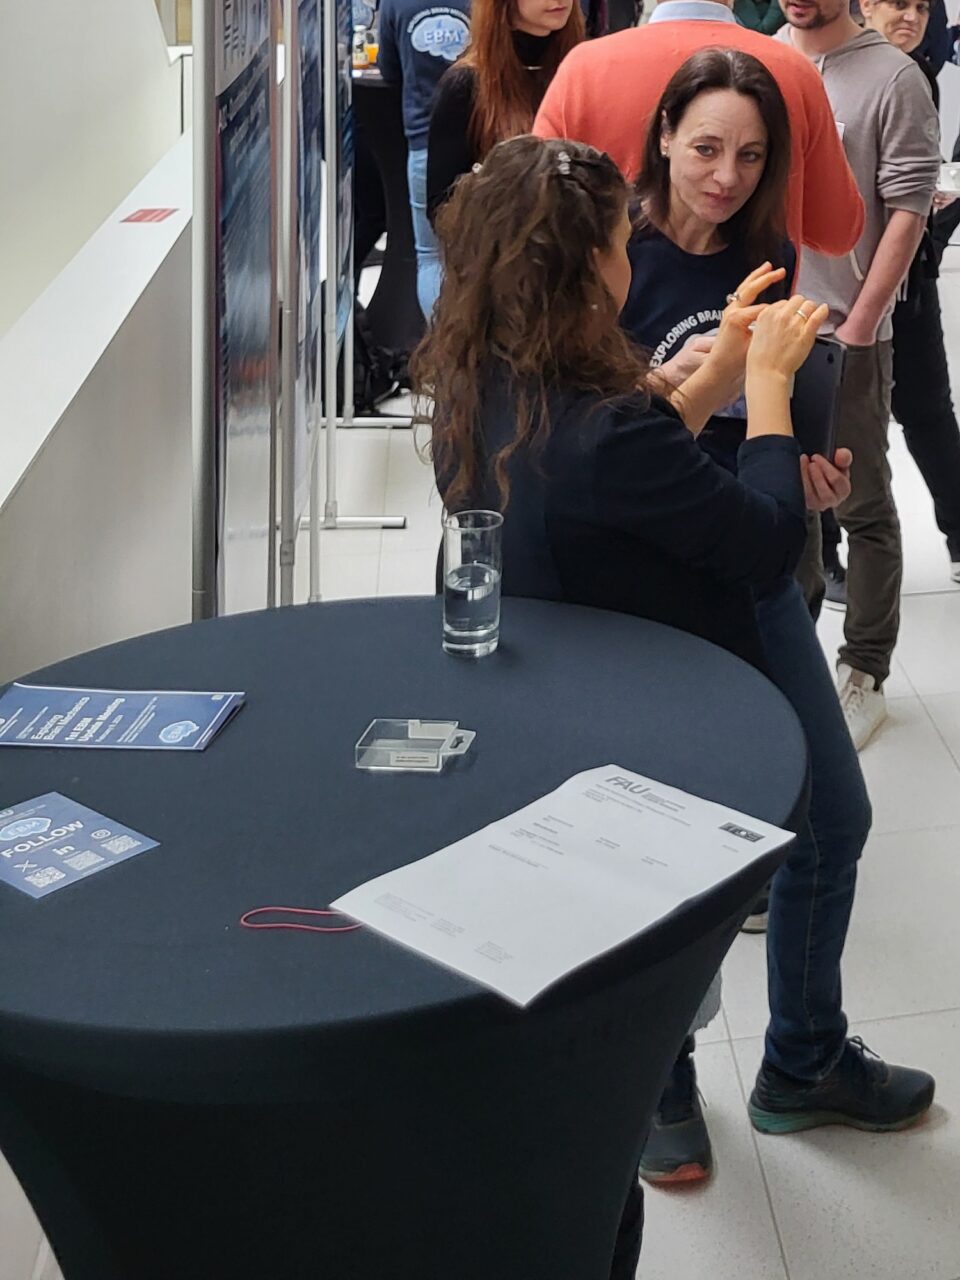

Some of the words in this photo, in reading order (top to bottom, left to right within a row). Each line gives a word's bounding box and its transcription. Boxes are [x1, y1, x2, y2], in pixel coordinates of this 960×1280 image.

[424, 30, 460, 44] EBM
[649, 315, 698, 368] EXPLORING
[697, 310, 725, 323] BRAI
[605, 776, 652, 794] FAU
[1, 820, 85, 858] FOLLOW
